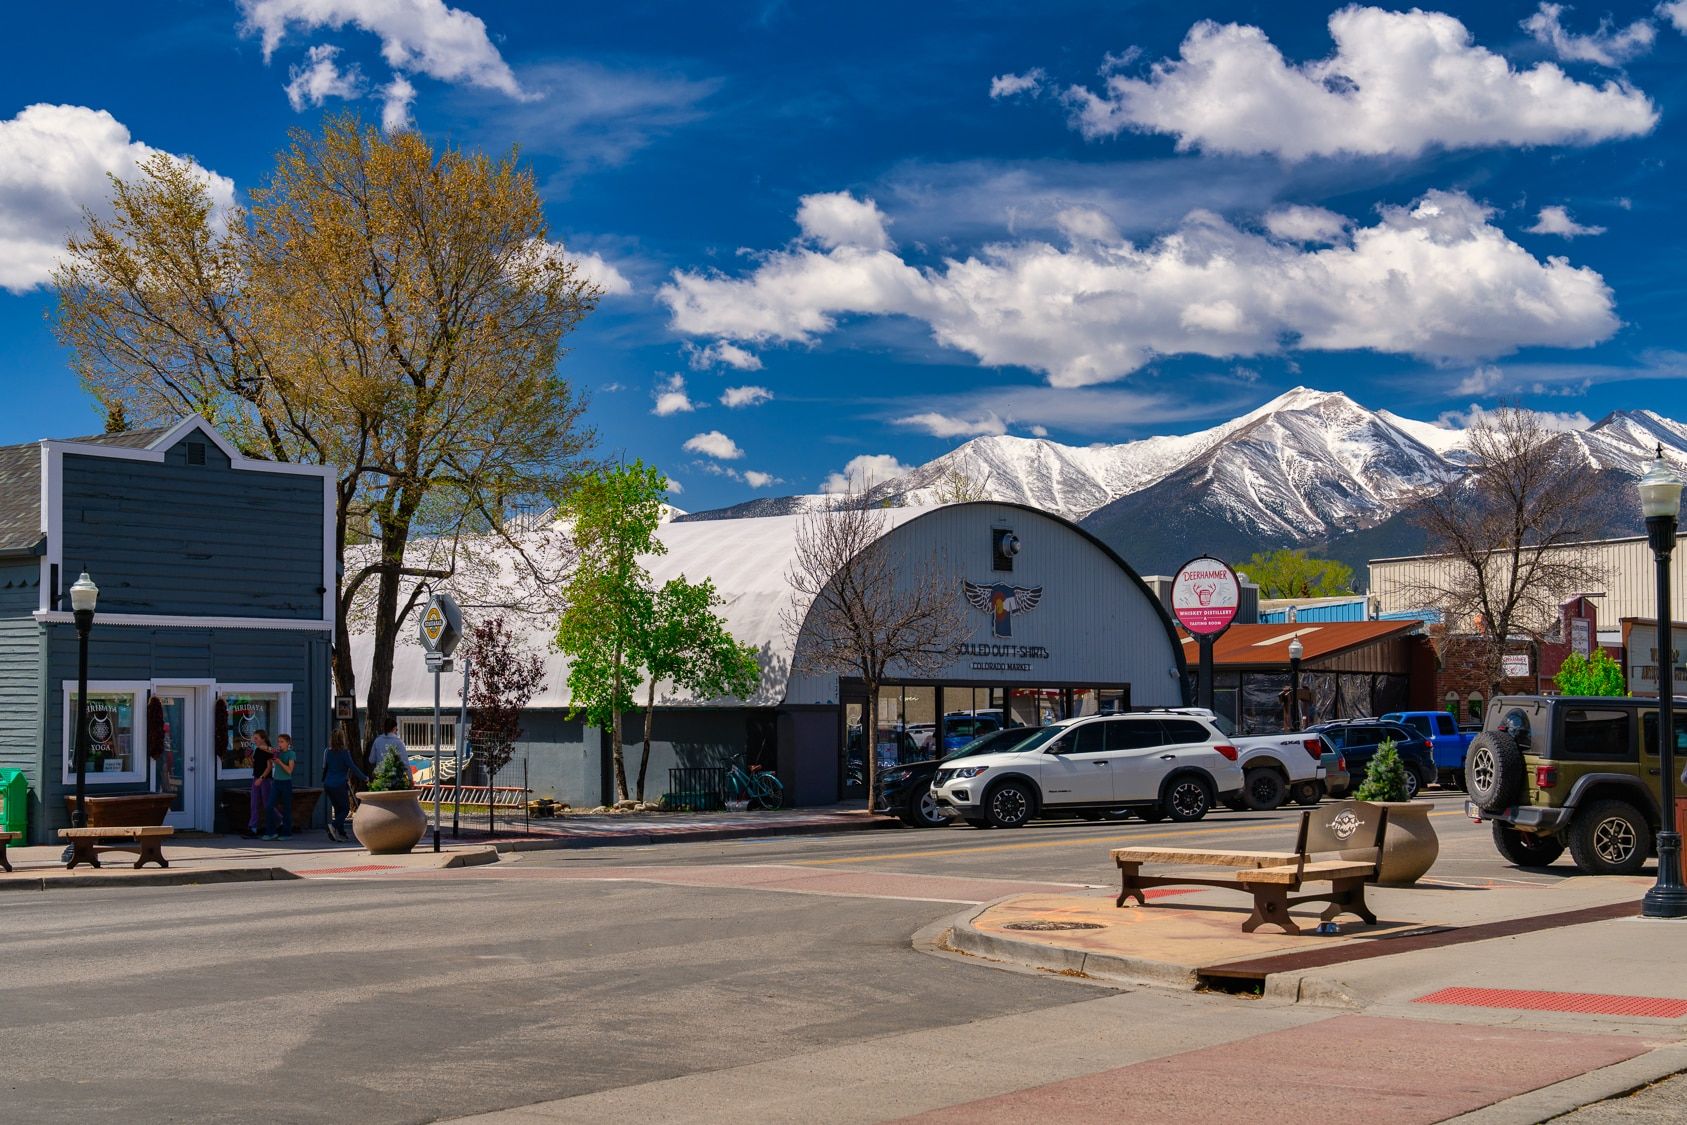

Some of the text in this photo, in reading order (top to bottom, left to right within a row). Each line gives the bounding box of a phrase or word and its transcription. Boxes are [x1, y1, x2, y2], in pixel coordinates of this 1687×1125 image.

[1183, 569, 1227, 581] DEERHAMMER
[992, 644, 1010, 657] OUT
[1011, 645, 1050, 659] T-SHIRTS
[972, 662, 1032, 671] COLORADO MARKET
[235, 704, 264, 712] HRIDAYA
[241, 741, 255, 749] YOG
